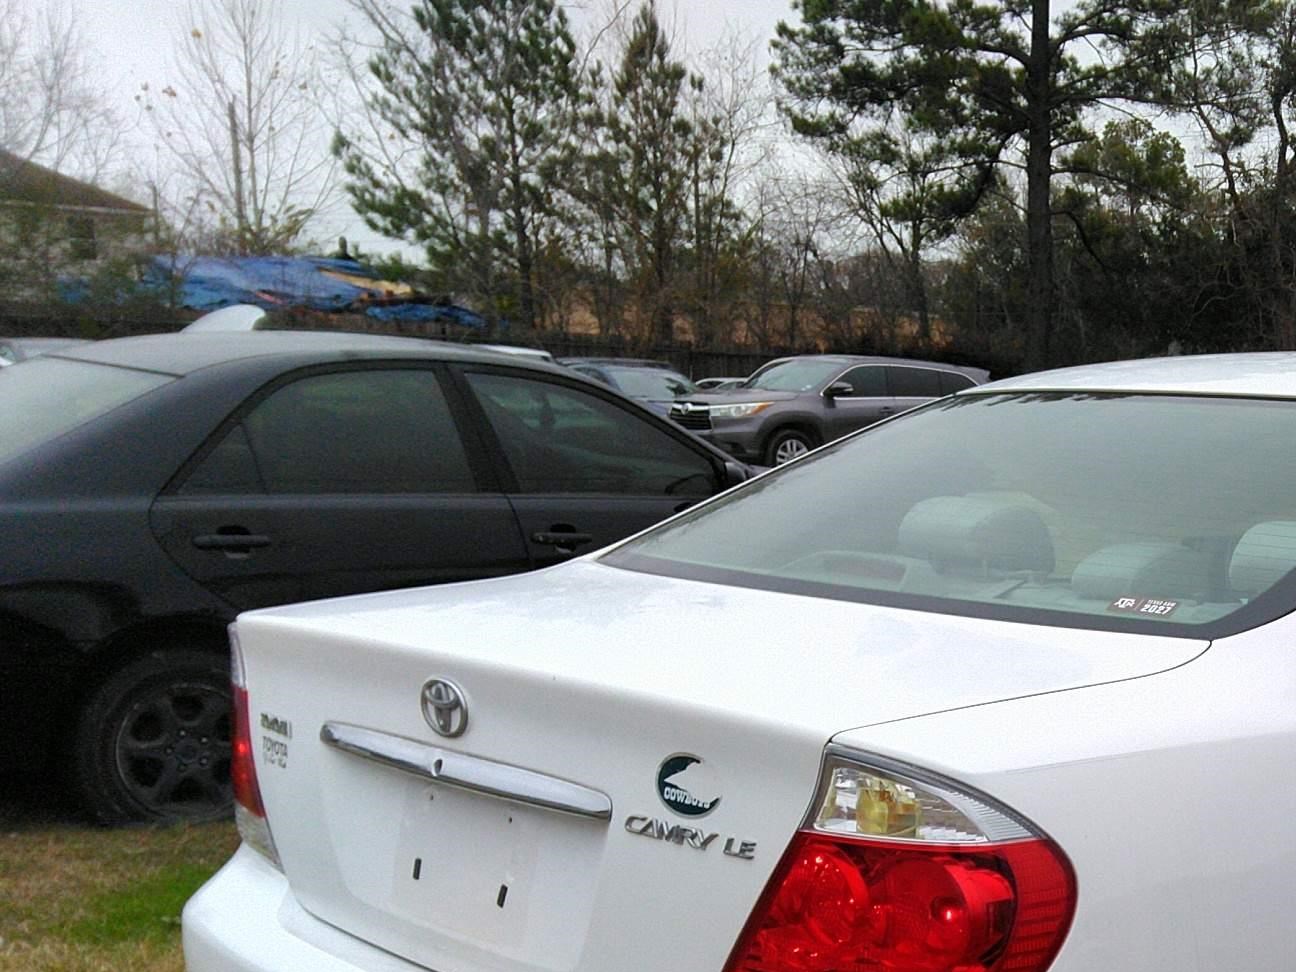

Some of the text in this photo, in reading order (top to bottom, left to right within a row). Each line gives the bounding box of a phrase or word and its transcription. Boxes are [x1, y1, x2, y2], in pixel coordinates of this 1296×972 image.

[1140, 603, 1172, 615] 2027
[624, 815, 757, 860] CAMRY LE
